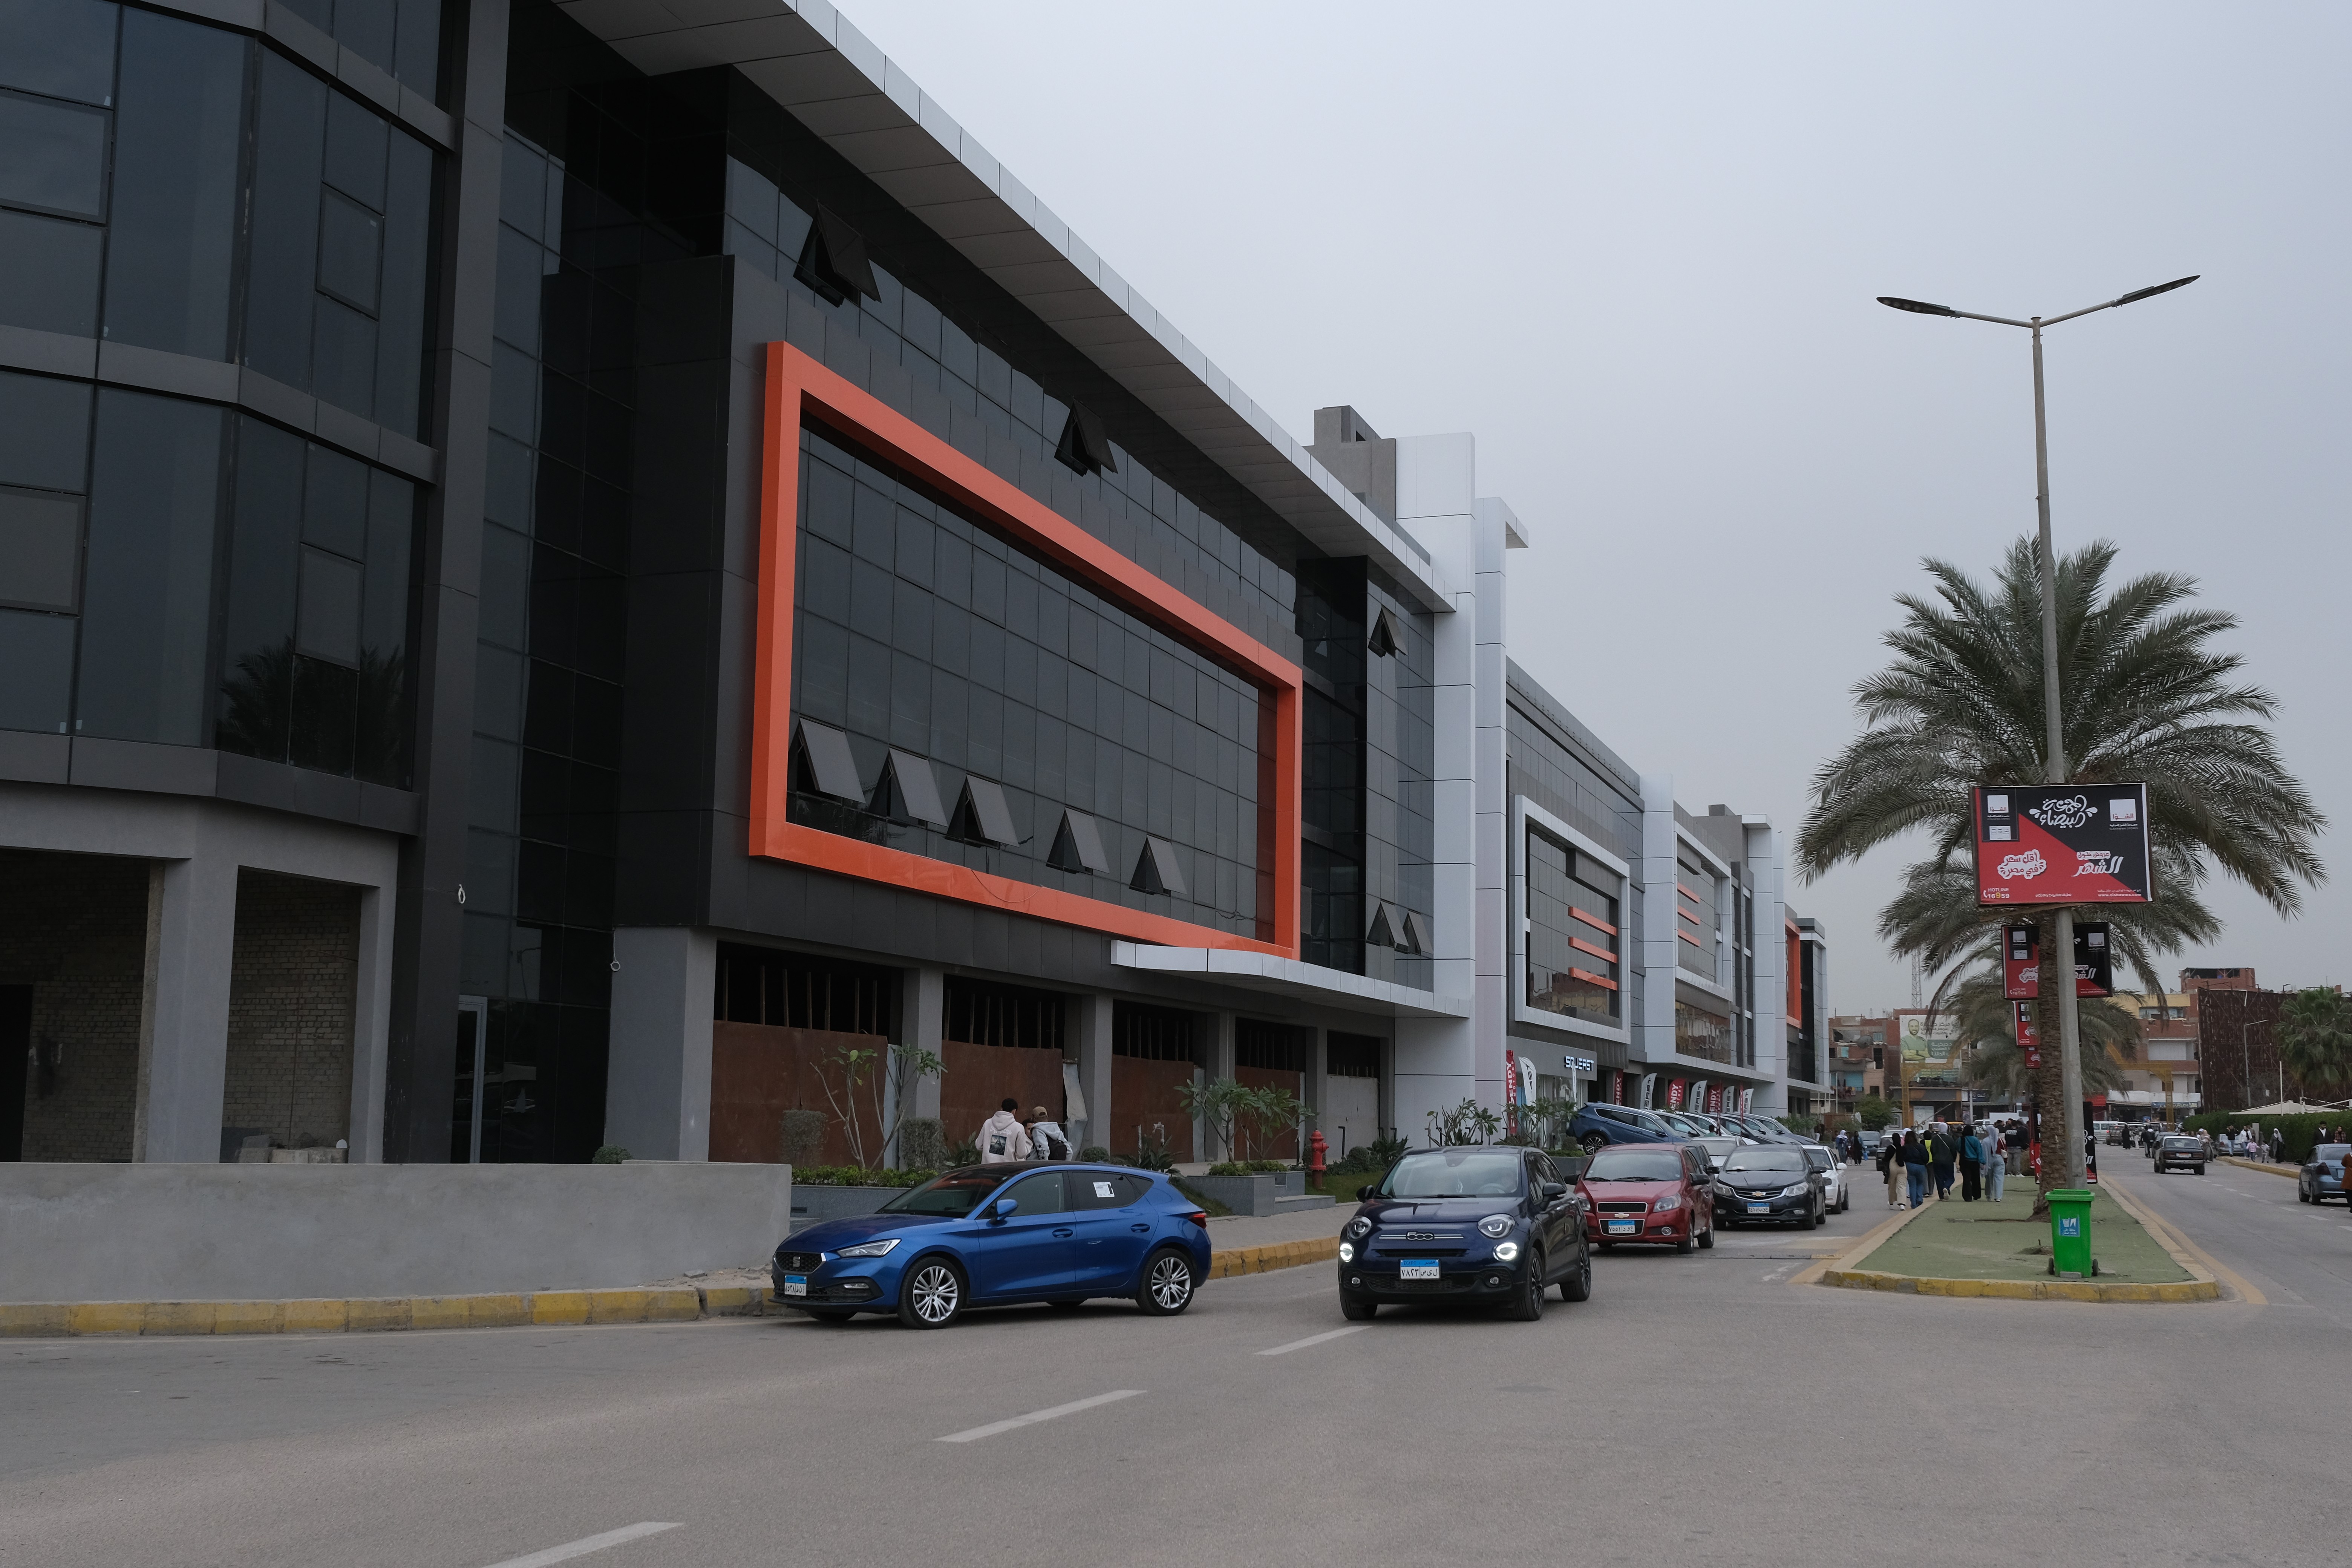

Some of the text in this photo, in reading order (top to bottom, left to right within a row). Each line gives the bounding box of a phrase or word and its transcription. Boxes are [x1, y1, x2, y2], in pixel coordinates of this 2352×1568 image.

[2040, 810, 2086, 828] البيضاء
[2003, 851, 2038, 866] أقل سعر
[2005, 864, 2038, 877] في مصر
[2070, 856, 2124, 877] الشهر
[1407, 1232, 1433, 1240] 500
